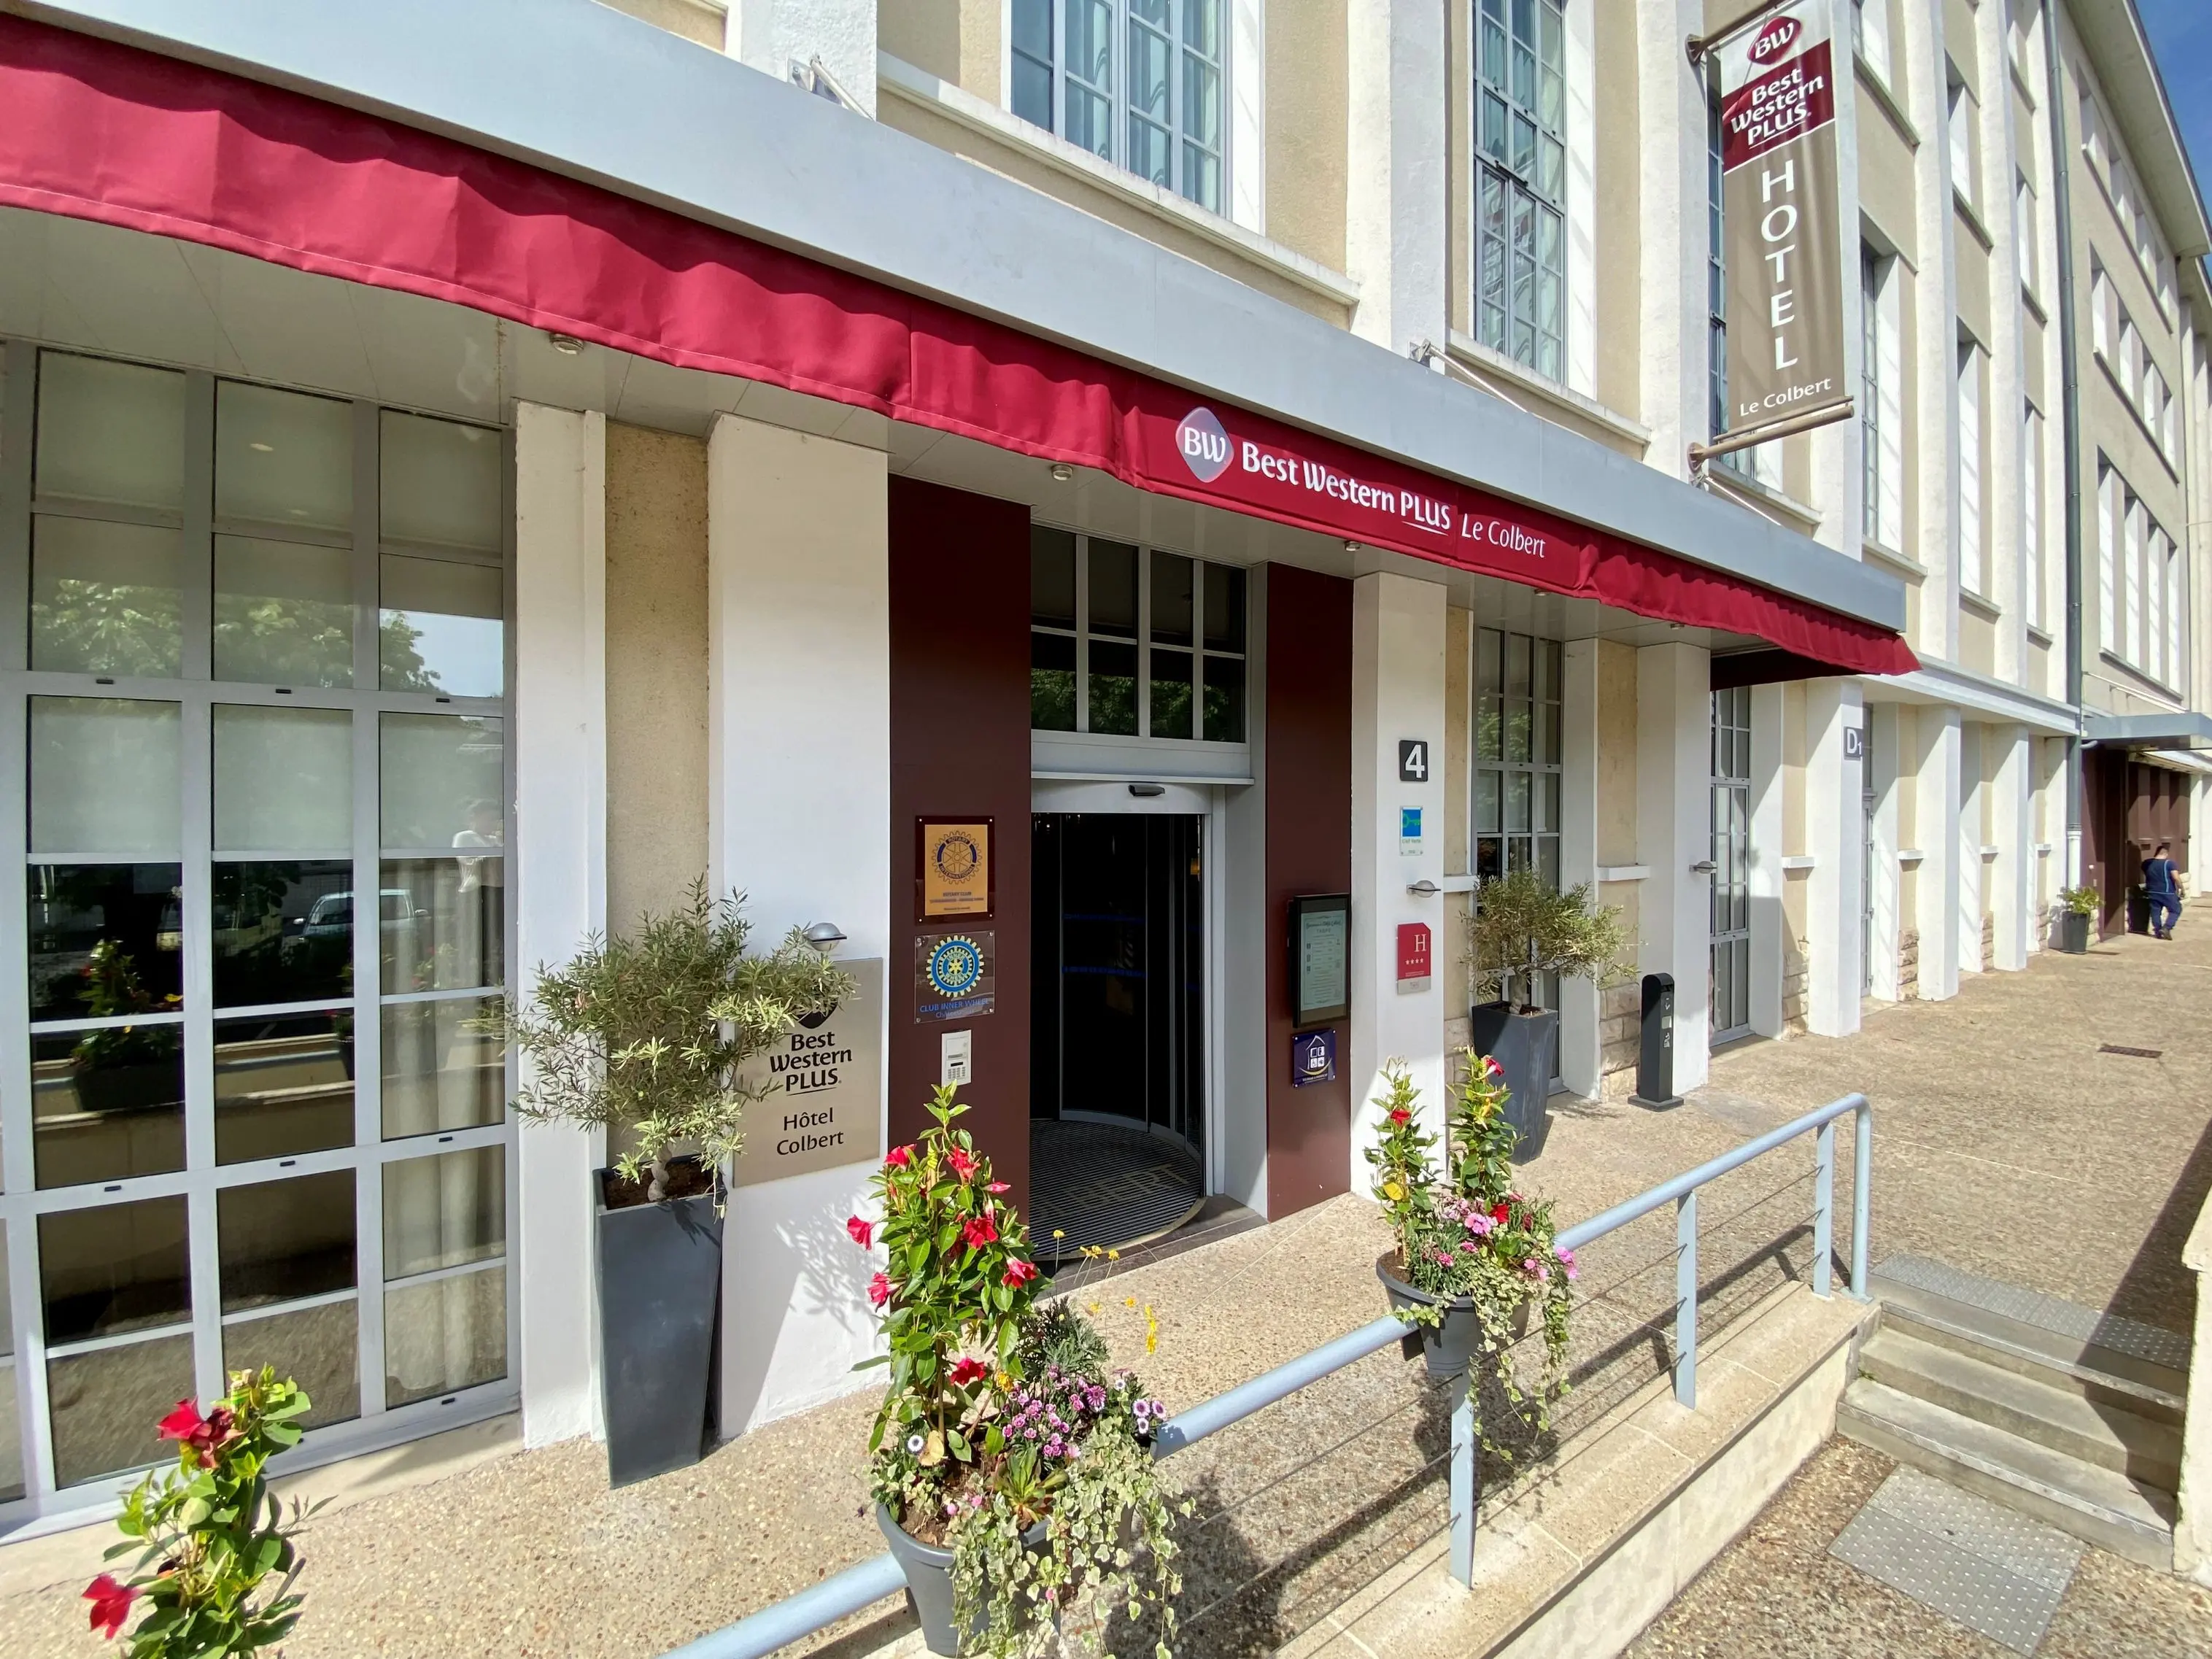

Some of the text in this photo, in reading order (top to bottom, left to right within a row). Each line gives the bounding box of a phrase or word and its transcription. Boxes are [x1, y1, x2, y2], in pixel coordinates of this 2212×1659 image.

[1755, 23, 1794, 59] BW
[1730, 75, 1824, 134] Western
[1752, 68, 1802, 106] Best
[1747, 101, 1808, 146] PLUS
[1760, 159, 1798, 371] HOTEL
[1739, 377, 1832, 417] Le Colbert
[1184, 427, 1226, 463] BW
[1242, 441, 1546, 558] Best Western PLUS Le Colbert
[1405, 744, 1426, 778] 4
[1414, 933, 1427, 953] H
[919, 1004, 939, 1013] CLUB
[940, 1000, 963, 1010] INNER
[791, 1032, 835, 1052] Best
[770, 1049, 852, 1072] Western
[786, 1067, 839, 1092] PLUS
[784, 1107, 834, 1132] Hôtel
[776, 1131, 844, 1156] Colbert
